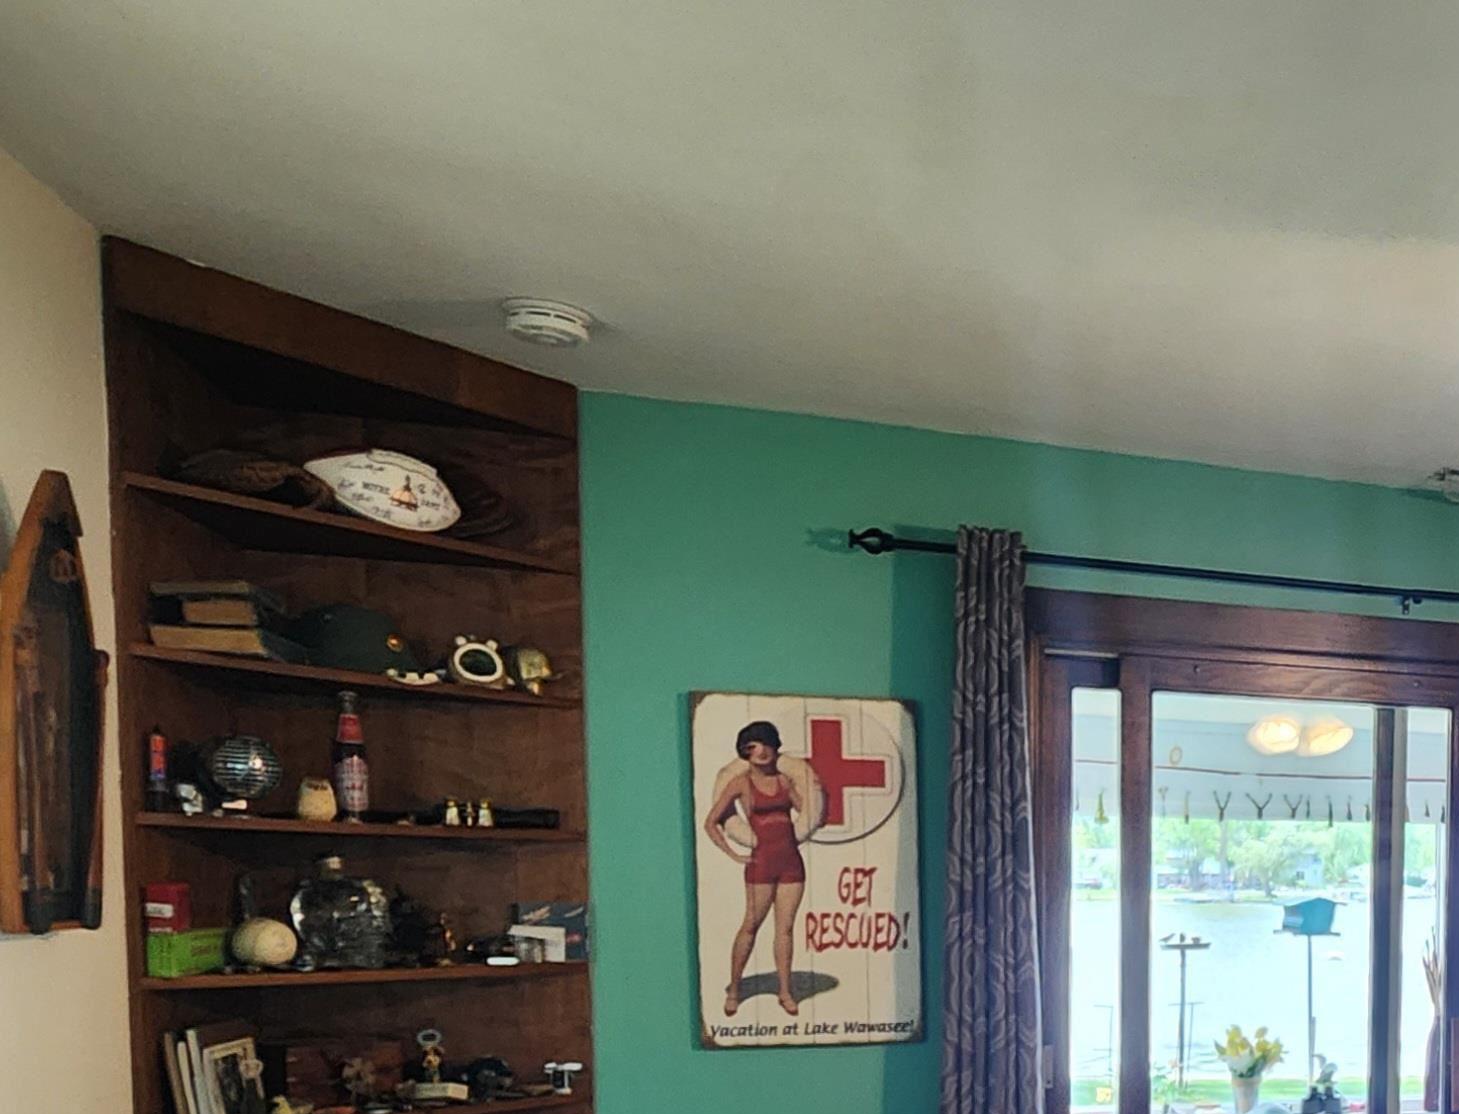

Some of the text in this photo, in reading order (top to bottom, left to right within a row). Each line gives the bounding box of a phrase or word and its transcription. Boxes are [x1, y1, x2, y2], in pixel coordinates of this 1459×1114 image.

[837, 866, 878, 907] GET
[805, 911, 910, 953] RESCUED!
[710, 1018, 915, 1038] Vacation at Lake Wawasee!
